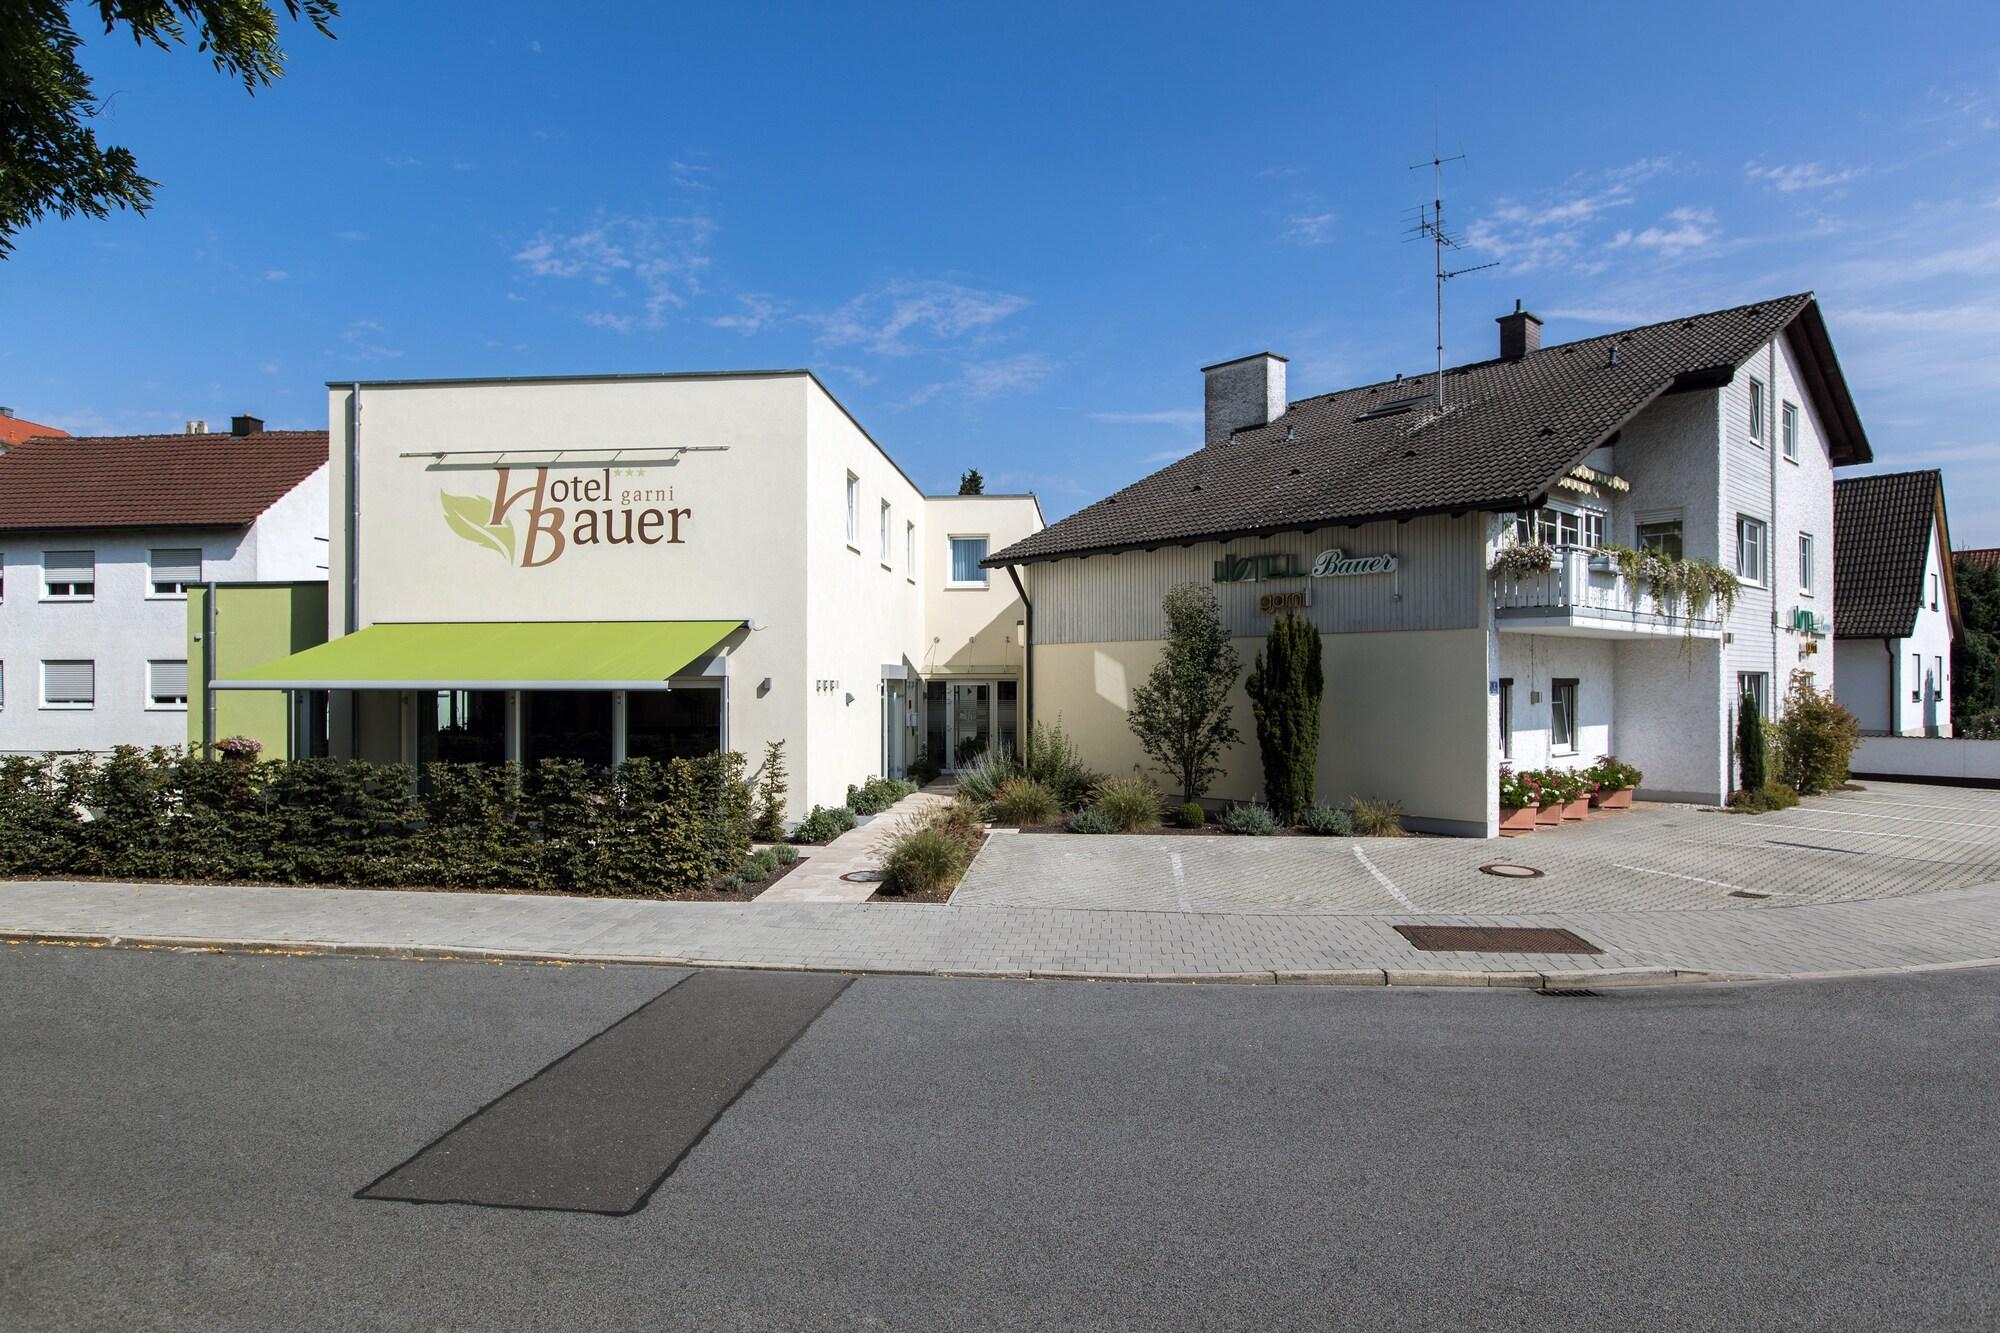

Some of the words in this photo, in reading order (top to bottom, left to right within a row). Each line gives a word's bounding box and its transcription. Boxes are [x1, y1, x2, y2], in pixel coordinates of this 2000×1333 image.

[490, 466, 612, 526] Hotel
[621, 485, 675, 506] garni
[519, 506, 692, 568] Bauer
[1313, 550, 1394, 576] Bauer
[1259, 590, 1308, 613] garni
